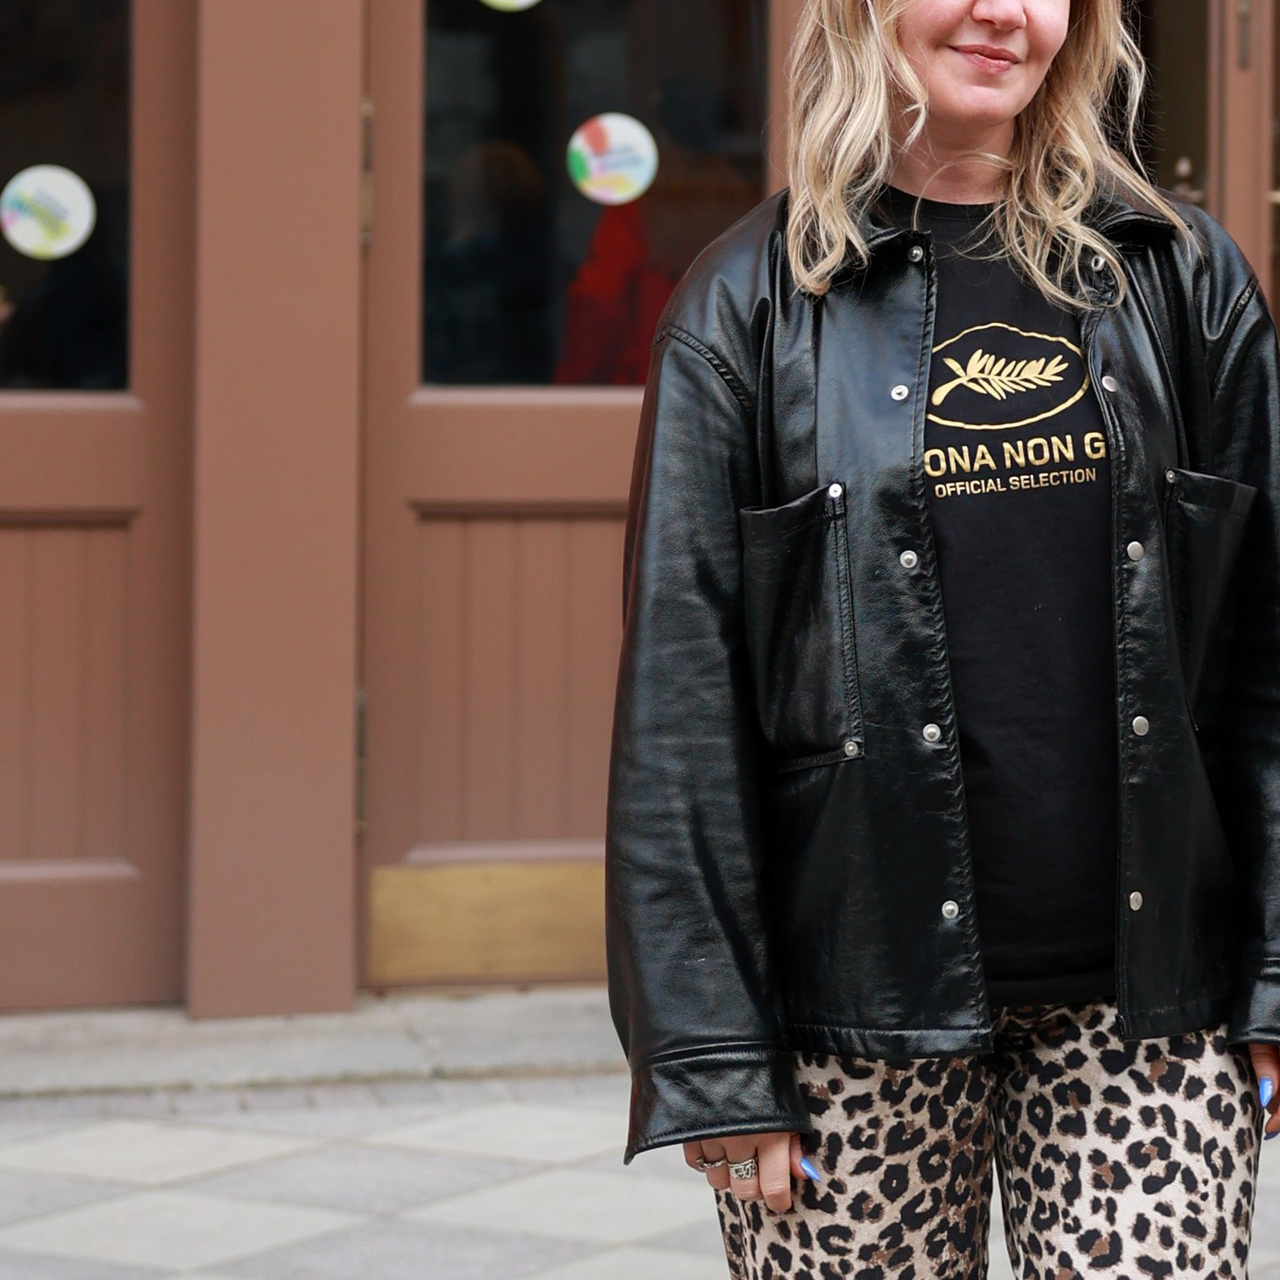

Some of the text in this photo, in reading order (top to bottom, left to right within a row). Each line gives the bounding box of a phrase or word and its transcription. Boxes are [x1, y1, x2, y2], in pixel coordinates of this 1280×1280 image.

[1002, 434, 1075, 469] NON
[934, 467, 1097, 499] OFFICIAL SELECTION
